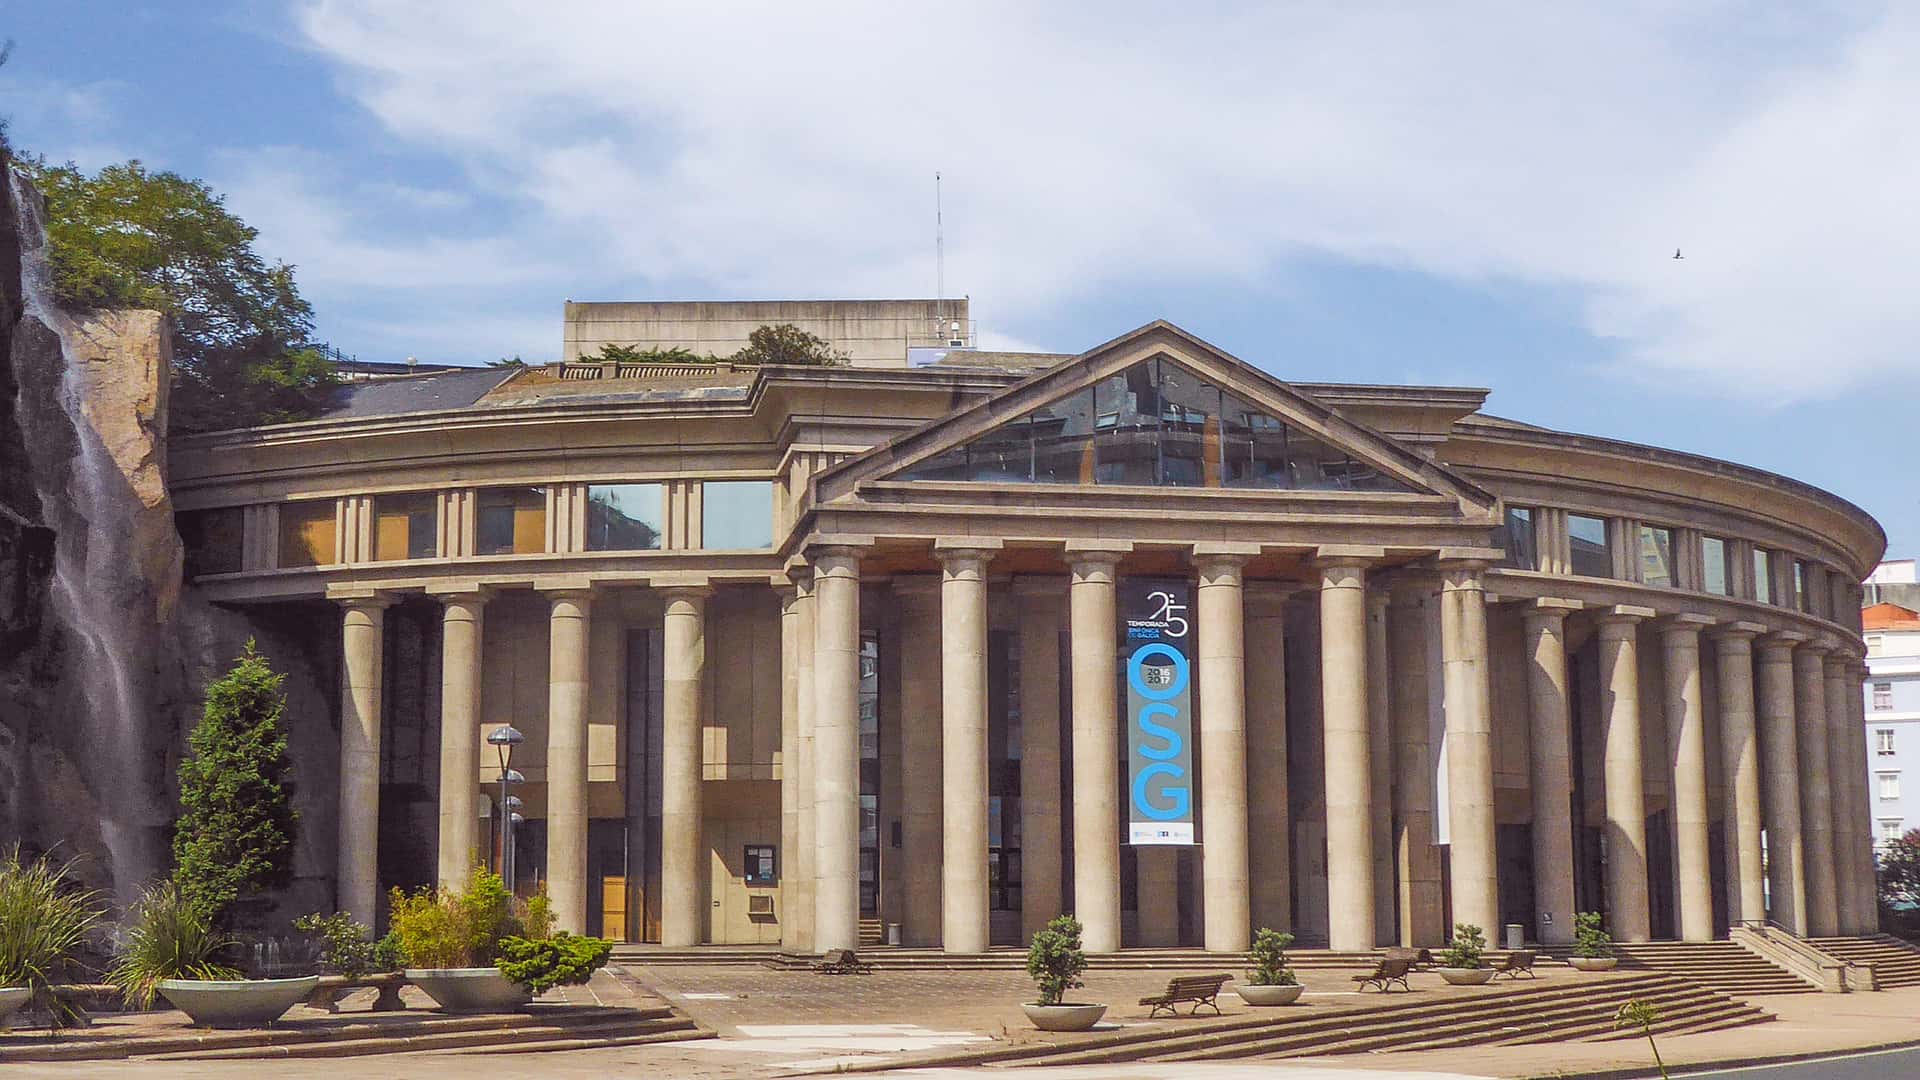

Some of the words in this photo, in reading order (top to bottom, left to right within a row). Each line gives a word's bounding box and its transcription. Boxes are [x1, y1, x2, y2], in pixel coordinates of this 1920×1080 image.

[1127, 620, 1169, 628] TEMPORADA
[1147, 668, 1170, 676] 2016
[1147, 676, 1170, 684] 2017
